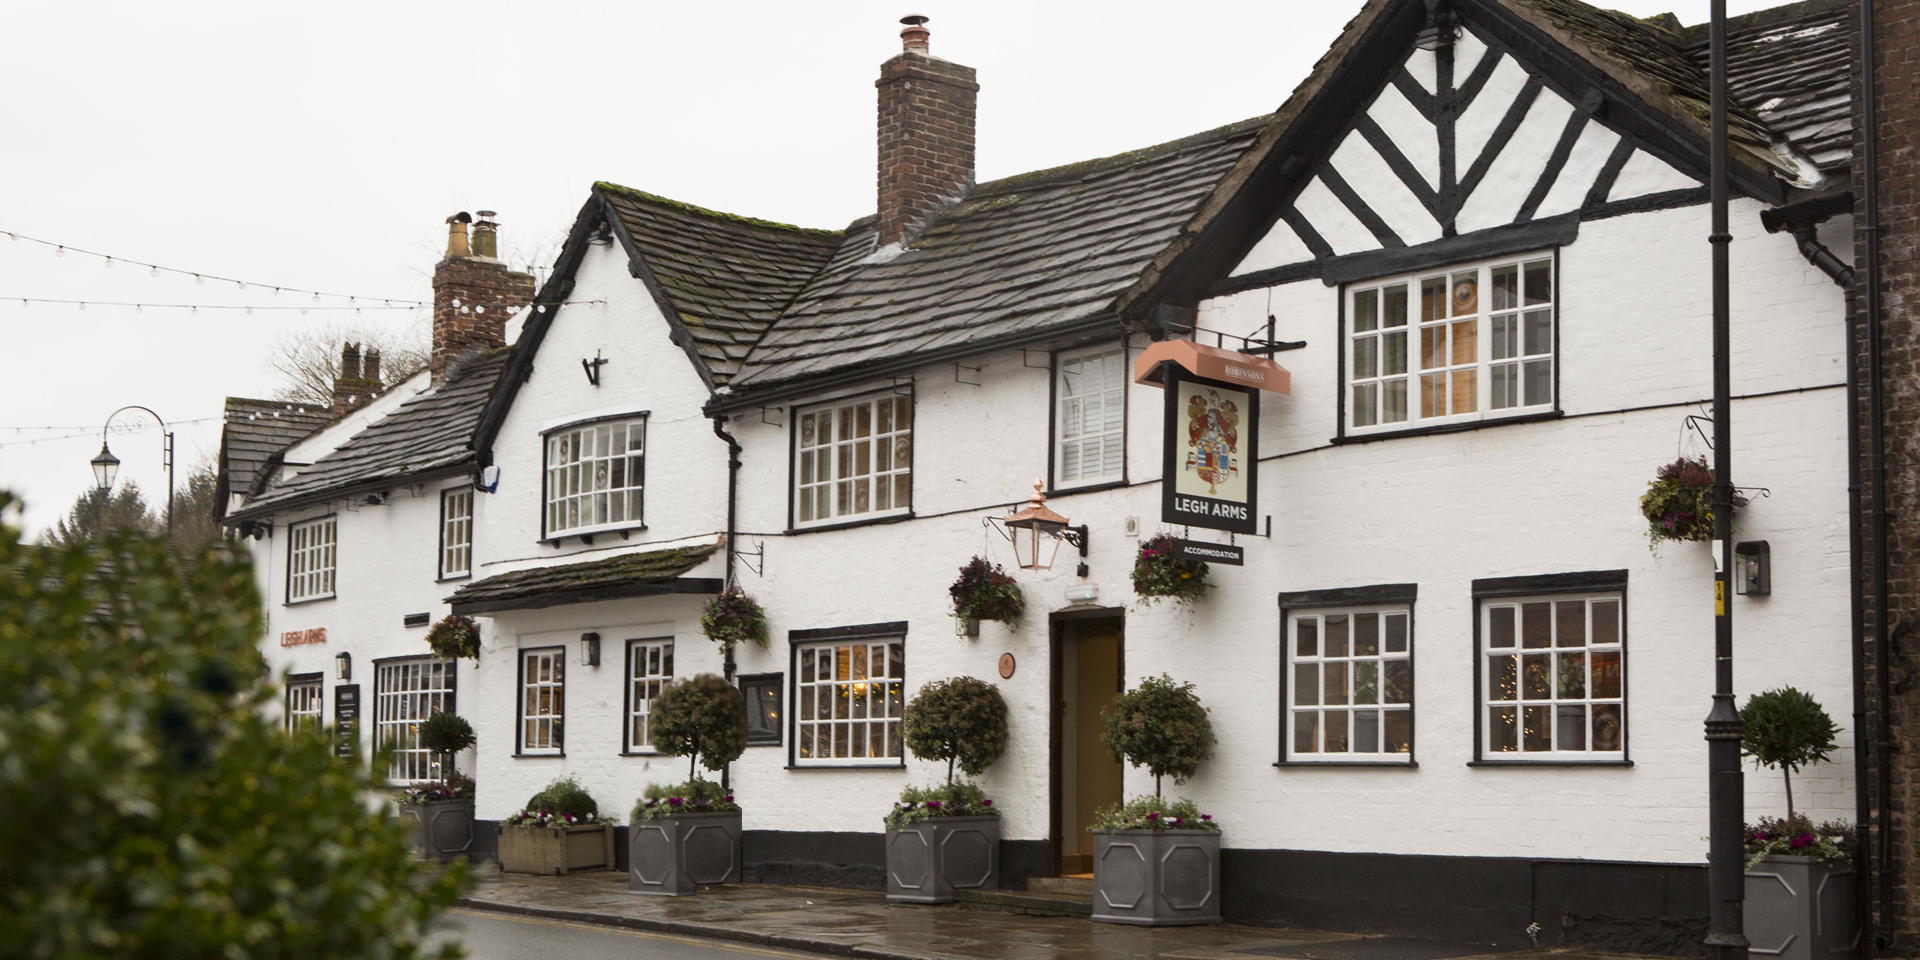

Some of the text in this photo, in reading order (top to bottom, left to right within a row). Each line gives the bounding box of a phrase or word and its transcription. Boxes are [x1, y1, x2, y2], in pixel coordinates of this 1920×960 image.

[1224, 365, 1265, 382] ROBINSONS
[1175, 497, 1248, 521] LEGH ARMS
[1183, 546, 1240, 560] ACCOMMODATION
